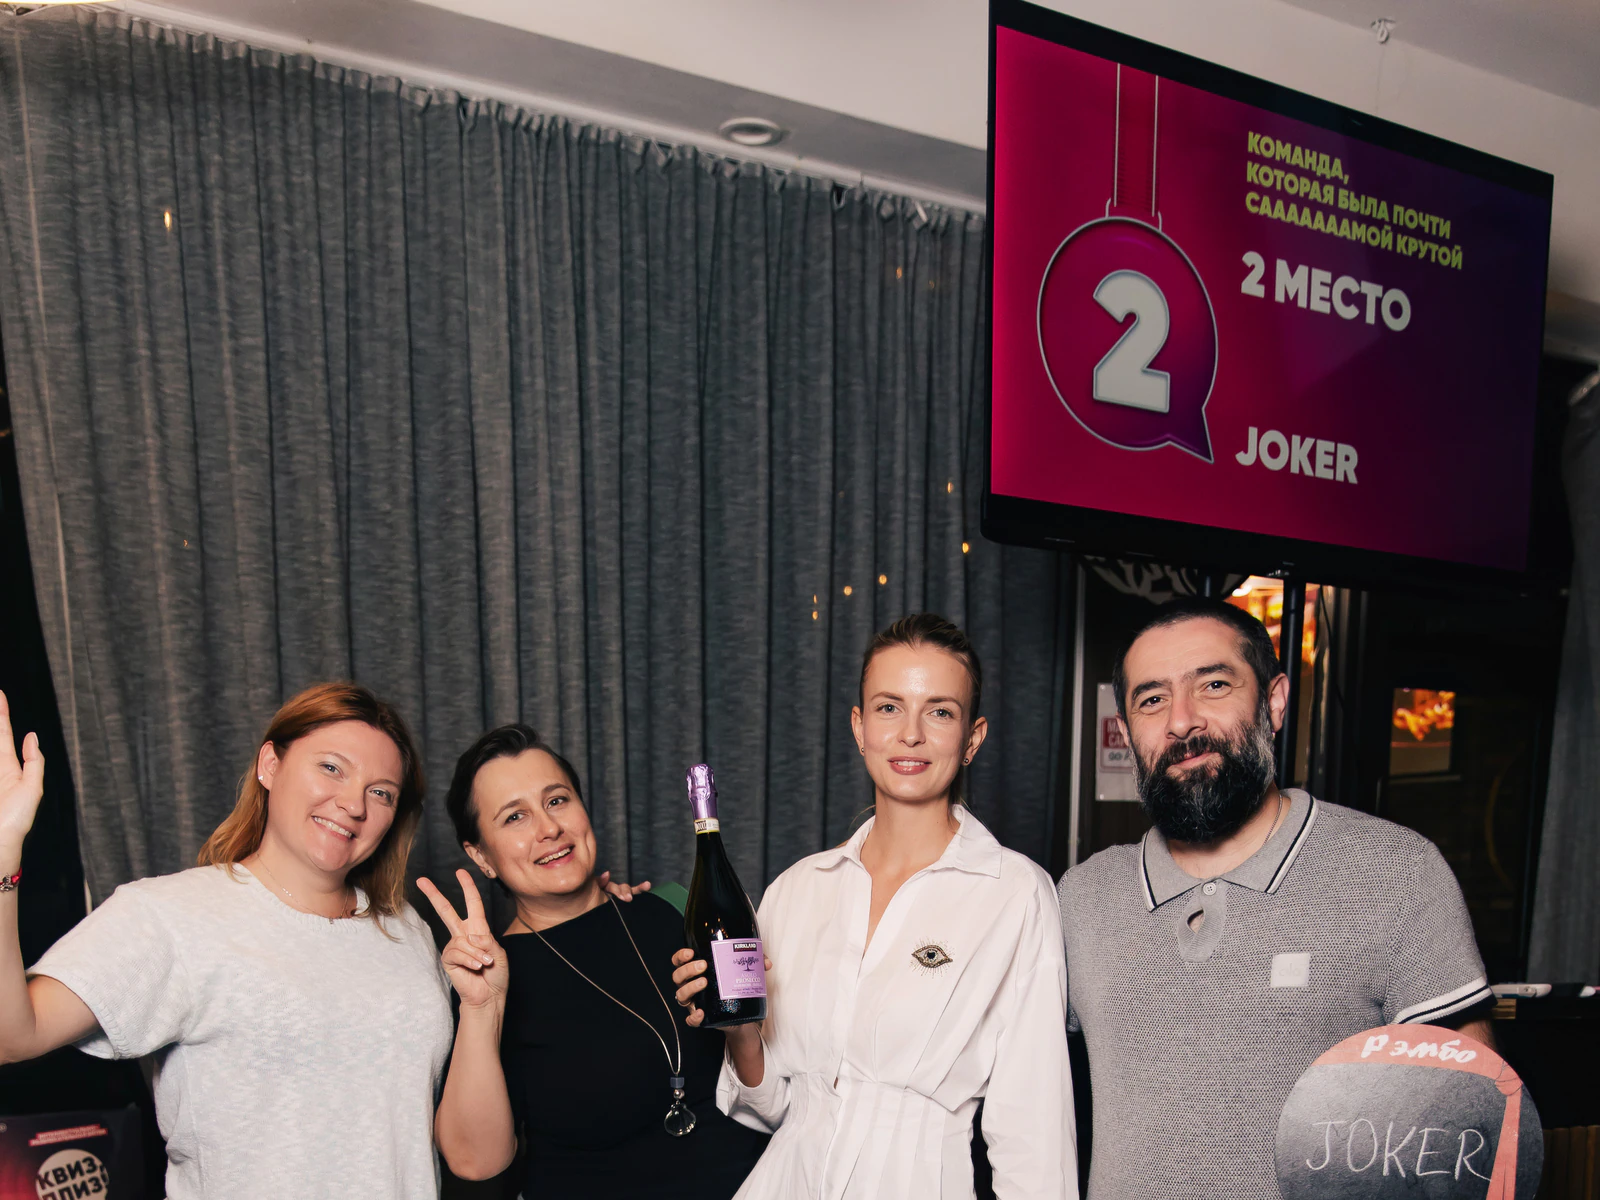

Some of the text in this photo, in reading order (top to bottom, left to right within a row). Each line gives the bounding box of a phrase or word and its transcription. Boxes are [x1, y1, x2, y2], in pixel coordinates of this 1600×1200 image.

[1247, 131, 1349, 185] КОМАНДА,
[1246, 161, 1451, 239] КОТОРАЯ БЫЛА ПОЧТИ
[1396, 233, 1463, 270] КРУТОЙ
[1241, 251, 1412, 331] 2 МЕСТО
[1093, 269, 1170, 413] 2
[1235, 426, 1358, 484] JOKER
[1361, 1034, 1477, 1064] Рэмбо
[1306, 1118, 1491, 1182] JOKER
